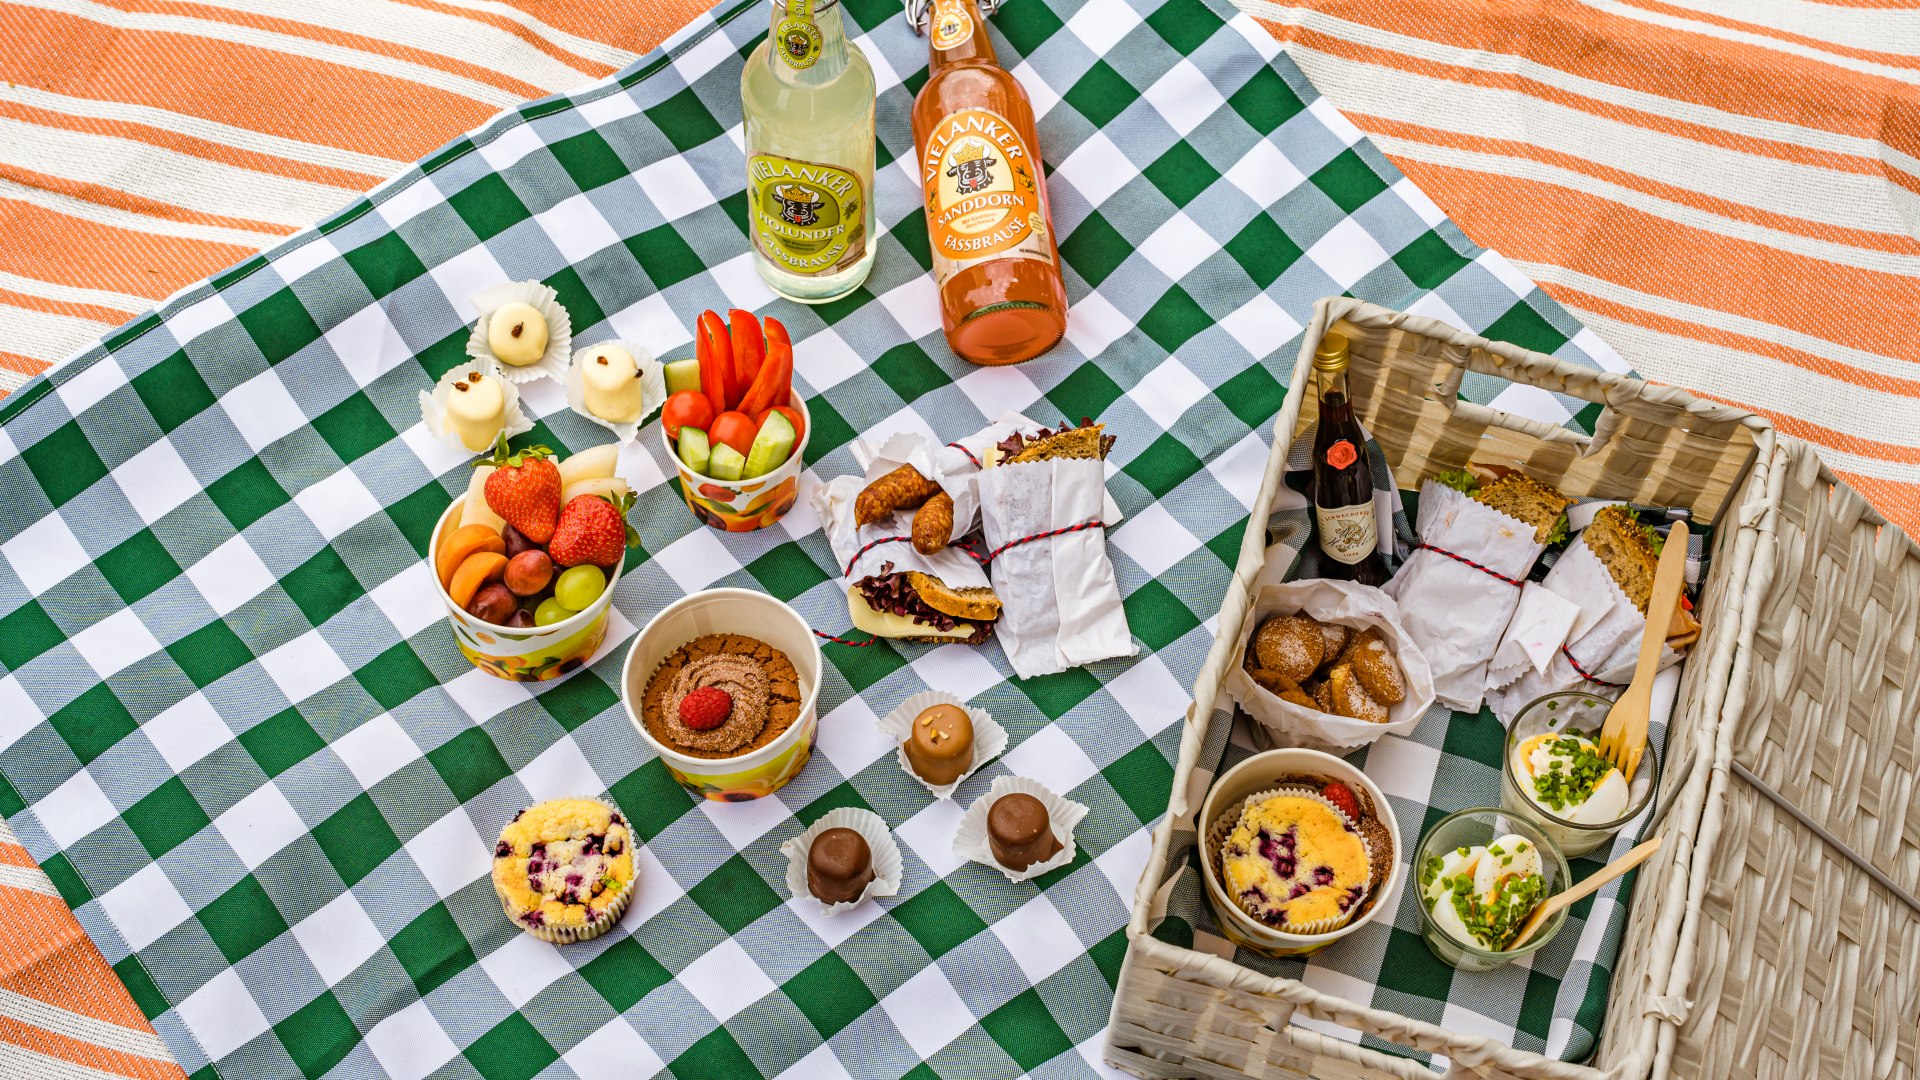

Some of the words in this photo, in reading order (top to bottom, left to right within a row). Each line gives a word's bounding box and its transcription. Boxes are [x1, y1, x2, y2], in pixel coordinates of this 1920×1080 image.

[780, 22, 820, 41] VIELANKER
[926, 115, 1023, 183] VIELANKER
[751, 161, 853, 198] VIELANKER
[760, 210, 846, 240] HOLUNDER
[938, 193, 1025, 228] SANDDORN
[762, 231, 845, 268] FASSBRAUSE
[944, 216, 1026, 252] FASSBRAUSE
